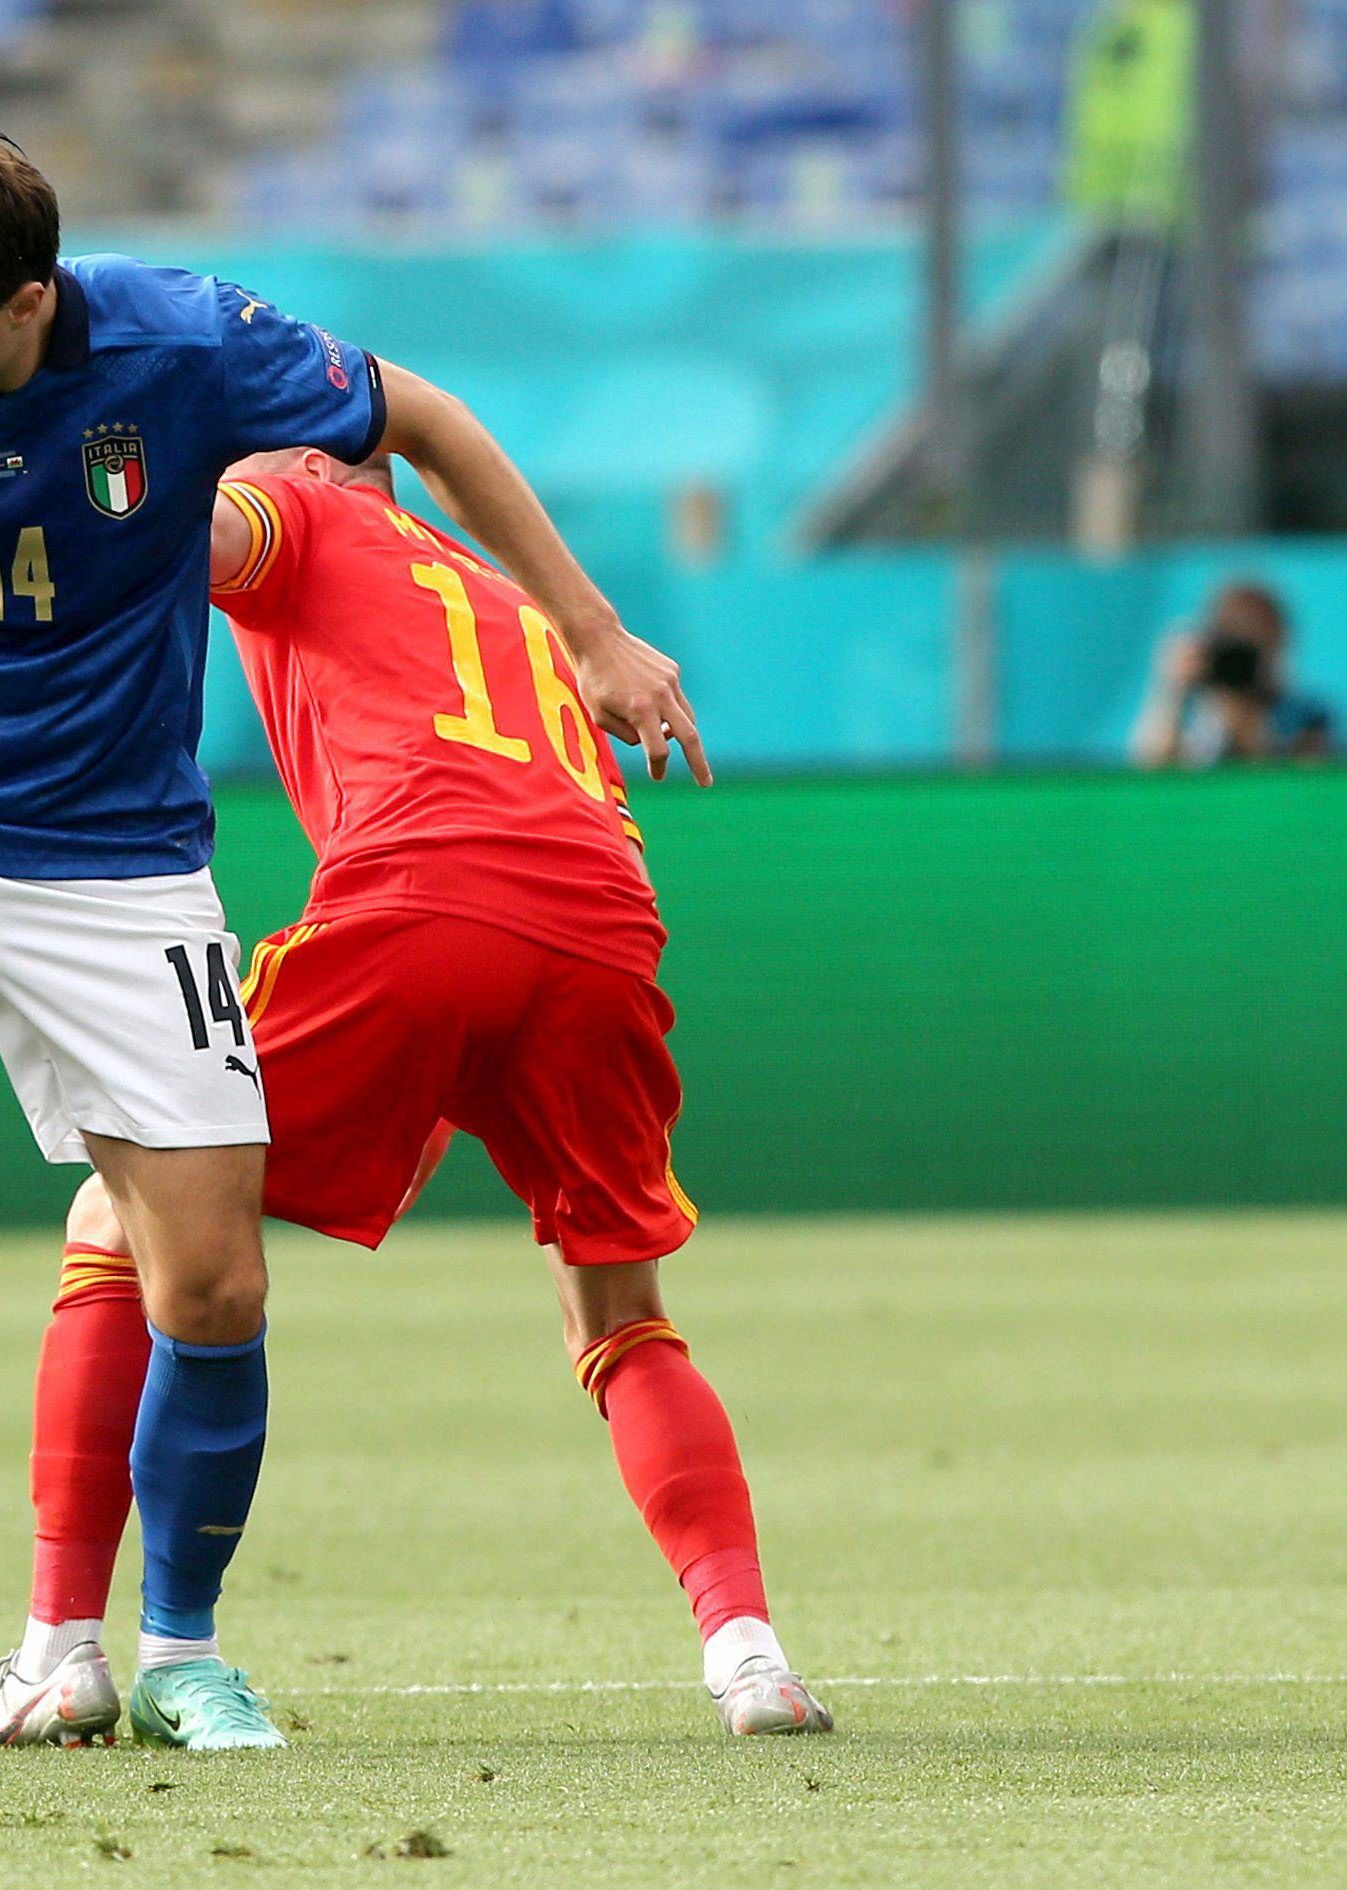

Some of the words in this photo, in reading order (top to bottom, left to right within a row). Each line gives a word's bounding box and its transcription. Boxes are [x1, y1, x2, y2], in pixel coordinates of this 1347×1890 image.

[88, 442, 138, 459] ITALIA
[410, 561, 606, 802] 16
[164, 942, 246, 1050] 14
